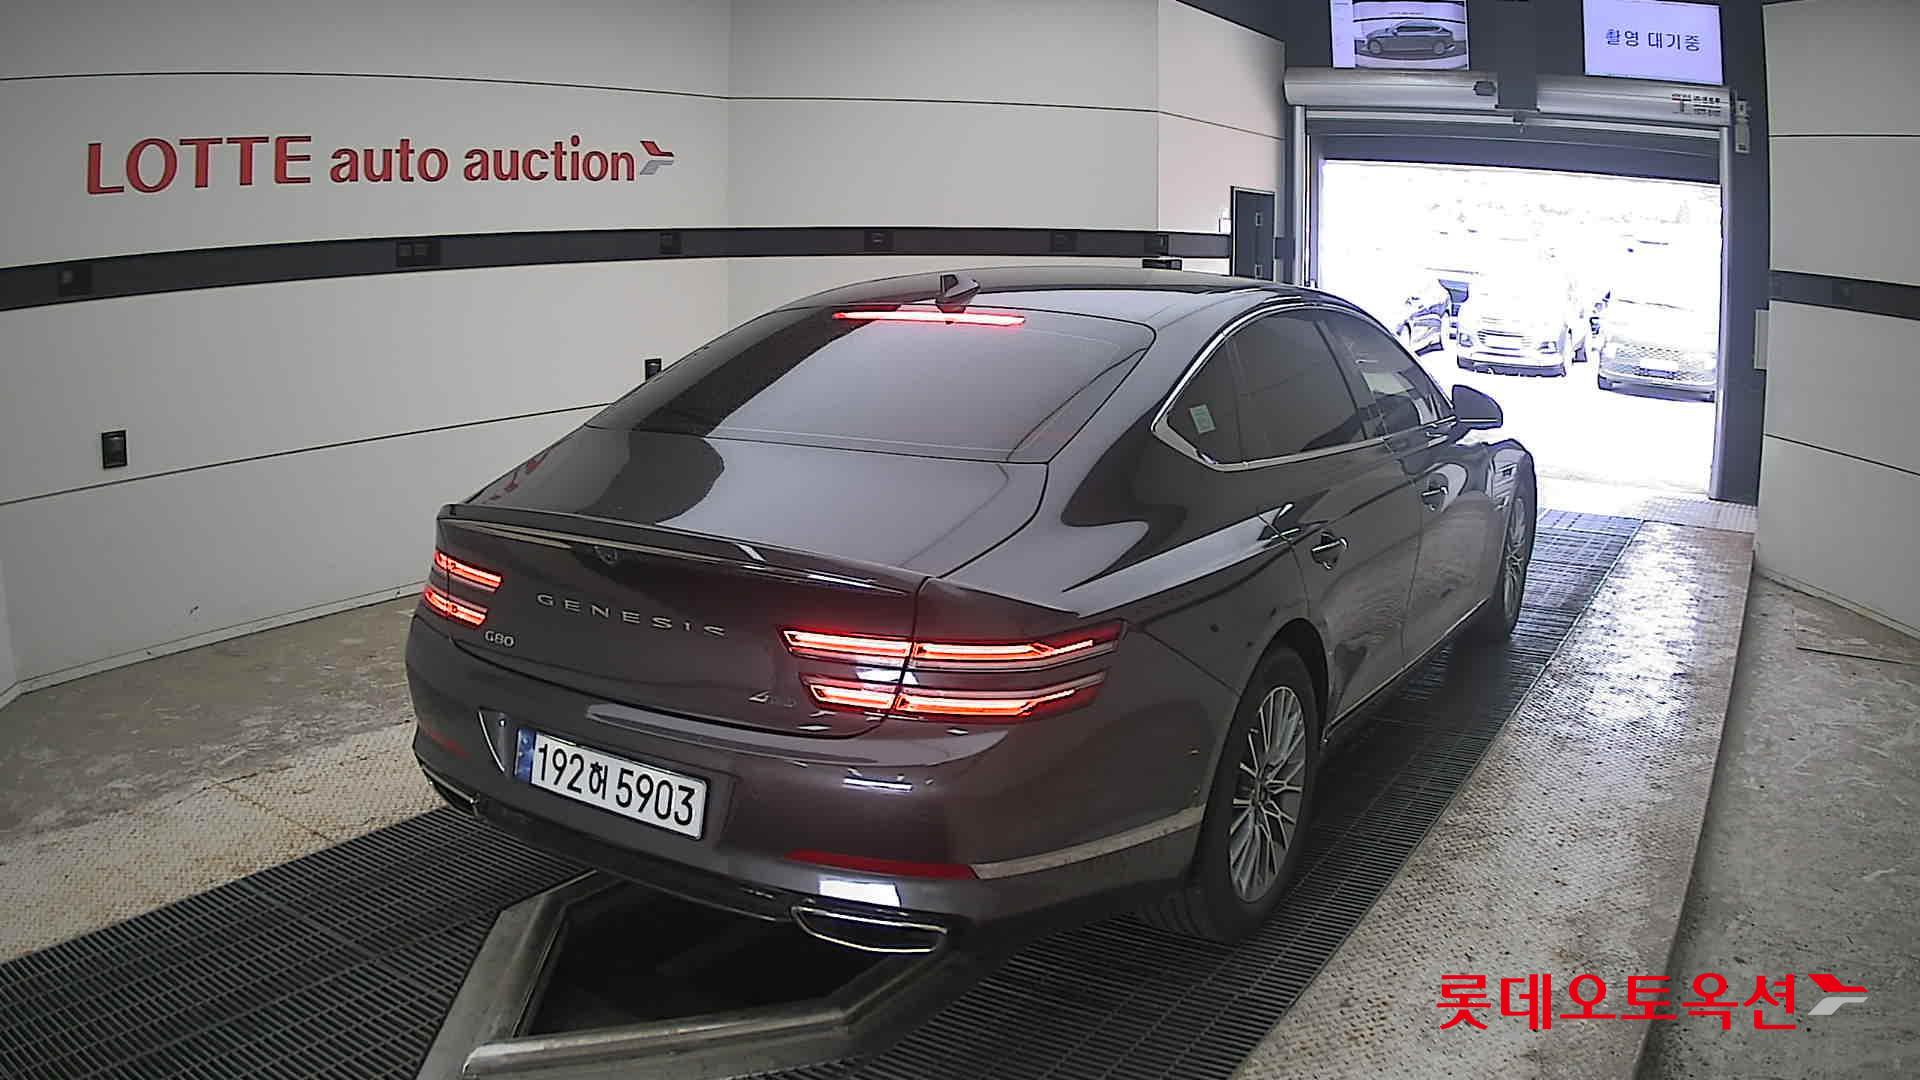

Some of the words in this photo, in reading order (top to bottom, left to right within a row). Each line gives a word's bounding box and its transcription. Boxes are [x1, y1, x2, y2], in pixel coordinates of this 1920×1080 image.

[1647, 31, 1701, 52] 대기중
[87, 135, 312, 195] LOTTE
[329, 138, 448, 183] auto
[463, 135, 635, 182] auction
[536, 593, 726, 637] GENESIS
[484, 629, 515, 648] G80
[538, 743, 609, 800] 192허
[615, 767, 696, 826] 5903
